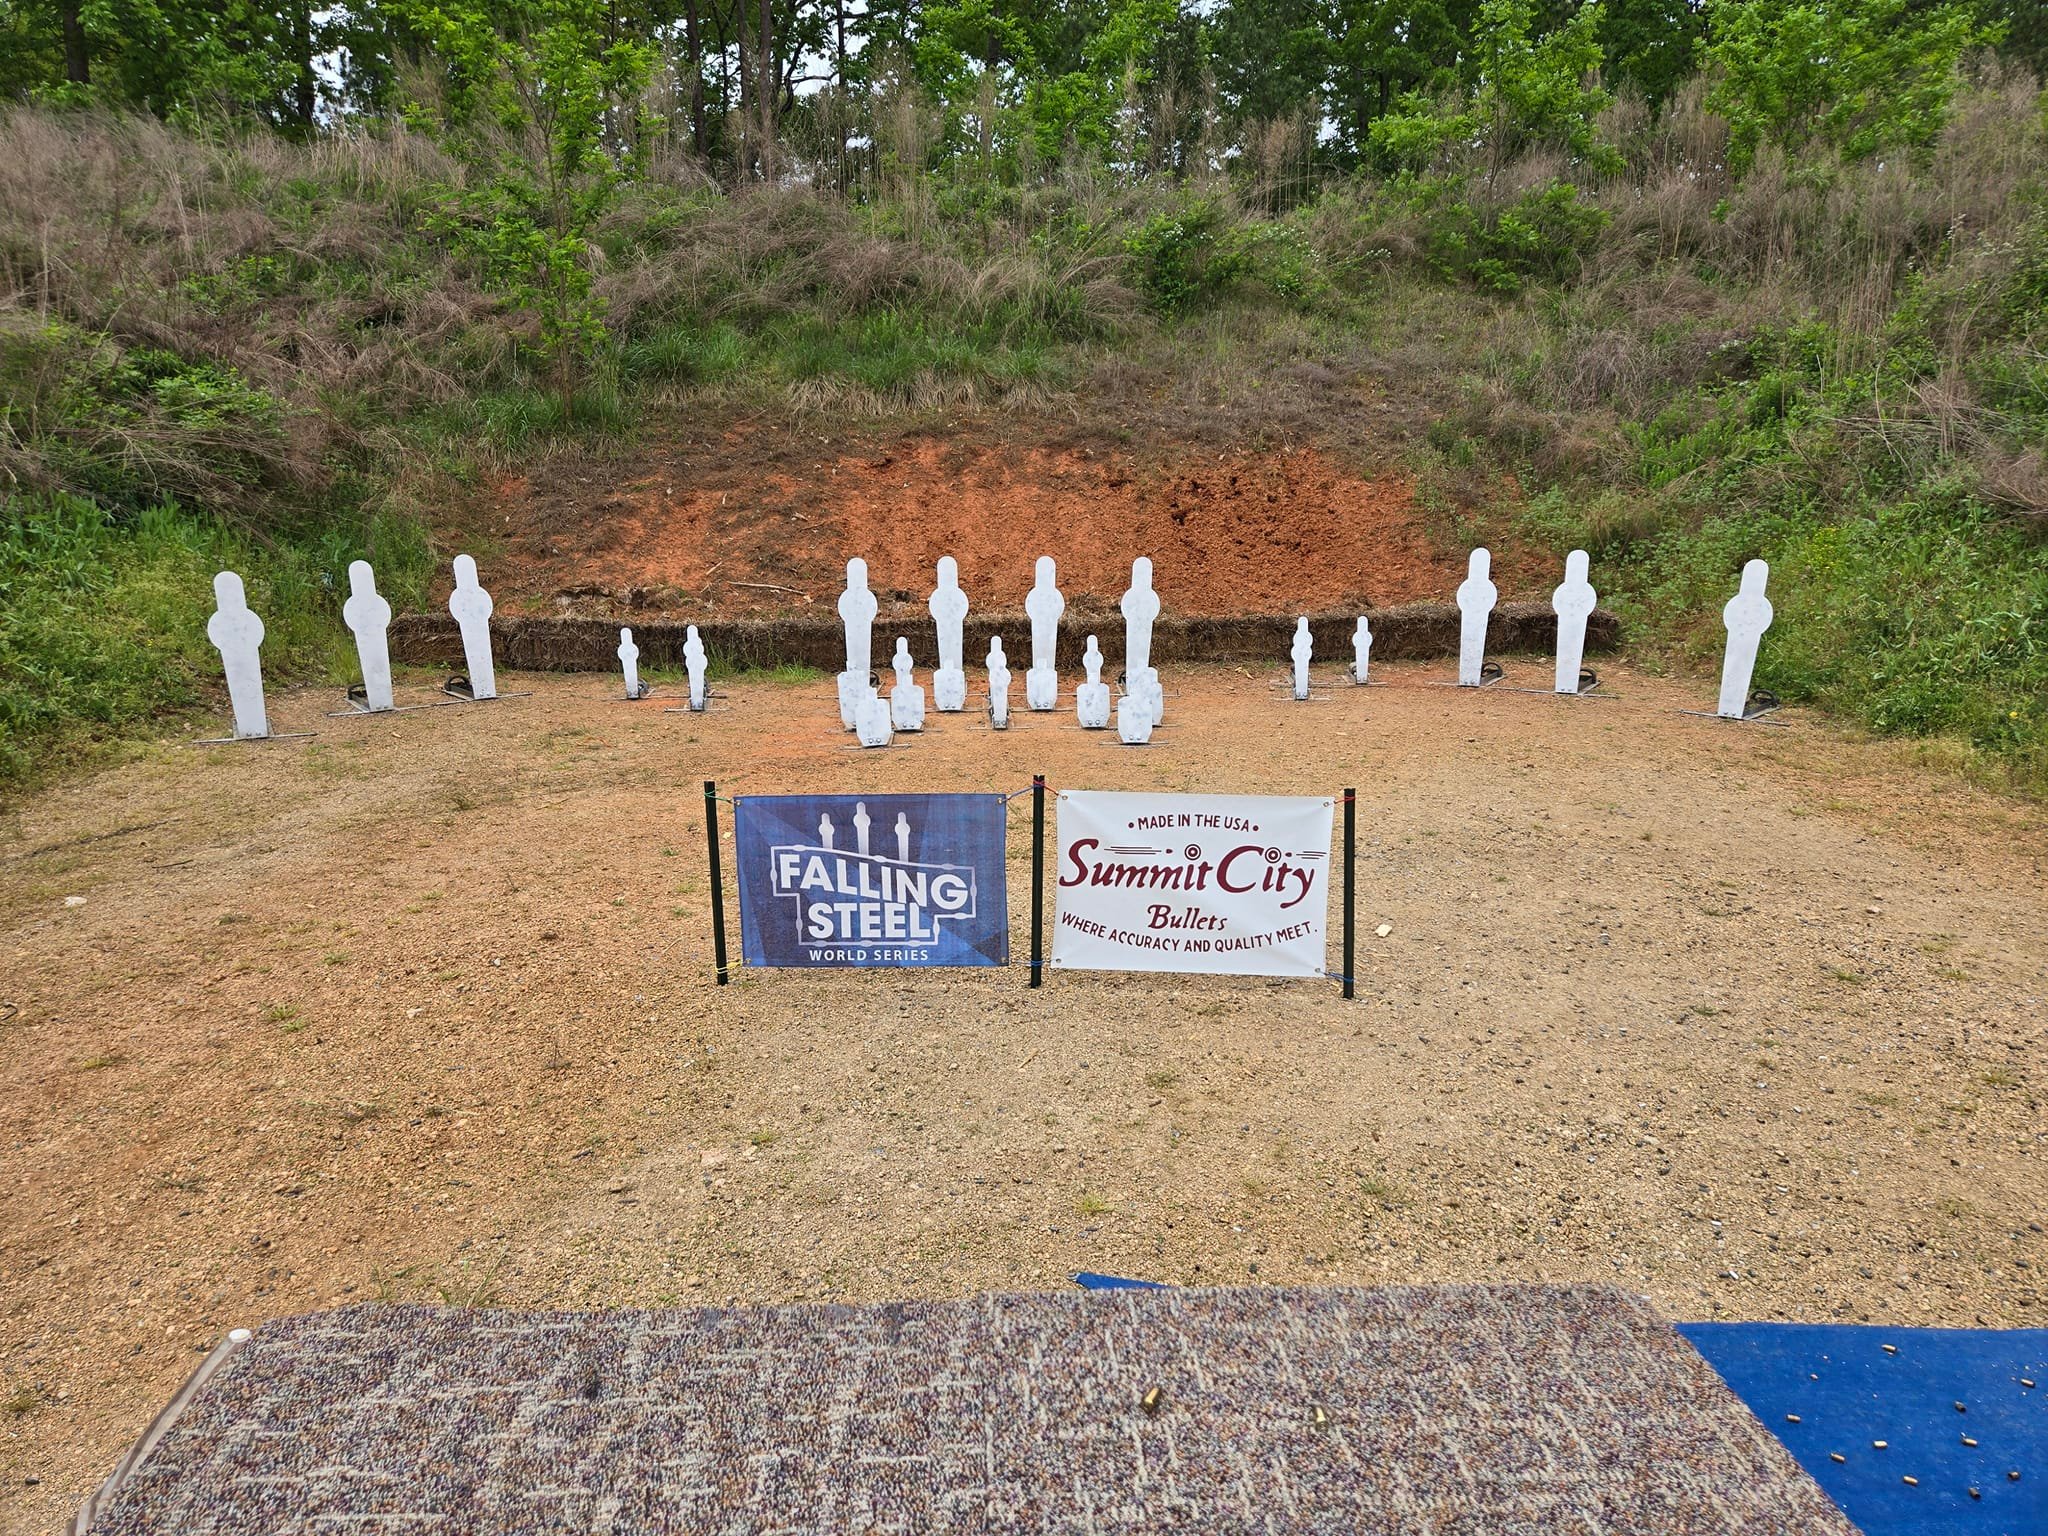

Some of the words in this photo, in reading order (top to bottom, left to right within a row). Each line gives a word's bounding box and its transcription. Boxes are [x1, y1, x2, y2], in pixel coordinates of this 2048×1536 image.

[1138, 814, 1174, 830] MADE
[1178, 814, 1191, 827] IN
[1194, 814, 1221, 828] THE
[1224, 816, 1250, 832] USA
[779, 853, 969, 910] FALLING
[1059, 838, 1214, 891] Summit
[1216, 844, 1315, 909] City
[808, 901, 930, 939] STEEL
[1061, 911, 1106, 938] WHERE
[1108, 929, 1179, 951] ACCURACY
[1184, 939, 1211, 953] AND
[1214, 934, 1273, 953] QUALITY
[1276, 921, 1318, 943] MEET.
[1147, 904, 1228, 931] Bullets
[809, 949, 867, 961] WORLD
[873, 949, 929, 961] SERIES
